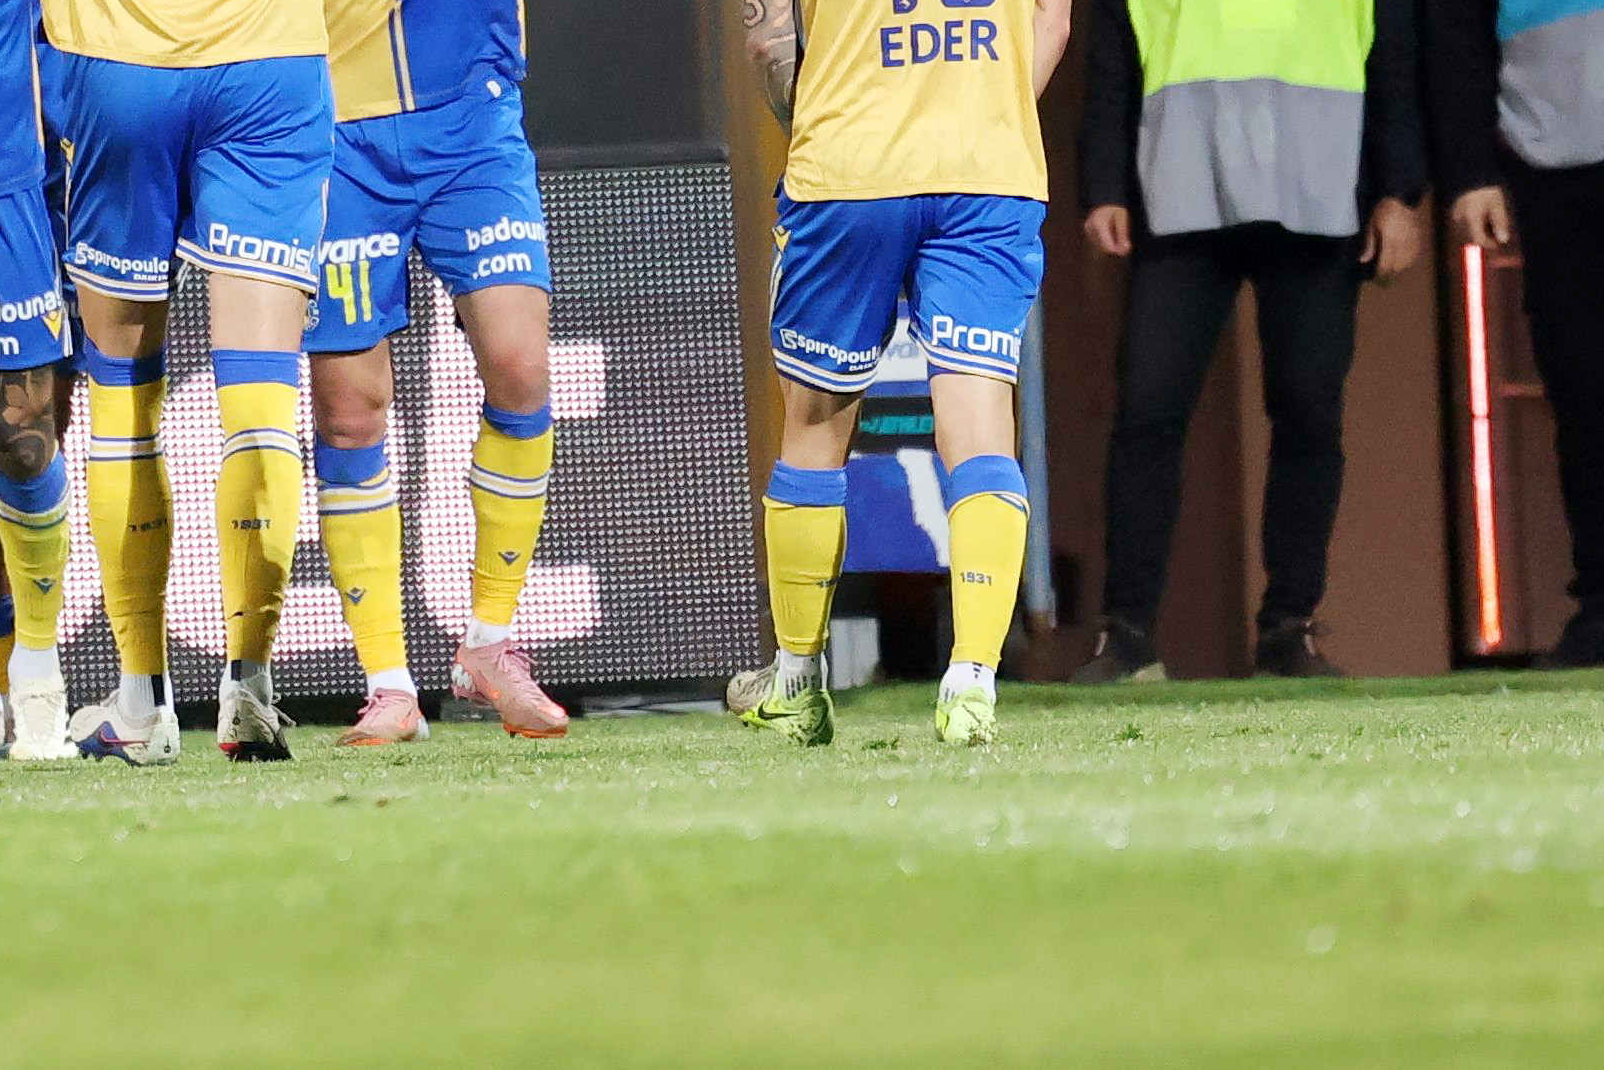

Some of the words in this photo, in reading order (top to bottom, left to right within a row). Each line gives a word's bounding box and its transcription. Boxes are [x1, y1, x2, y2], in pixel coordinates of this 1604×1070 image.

[879, 19, 1000, 69] EDER
[473, 252, 532, 280] .com
[325, 262, 372, 325] 41
[960, 571, 993, 585] 1931
